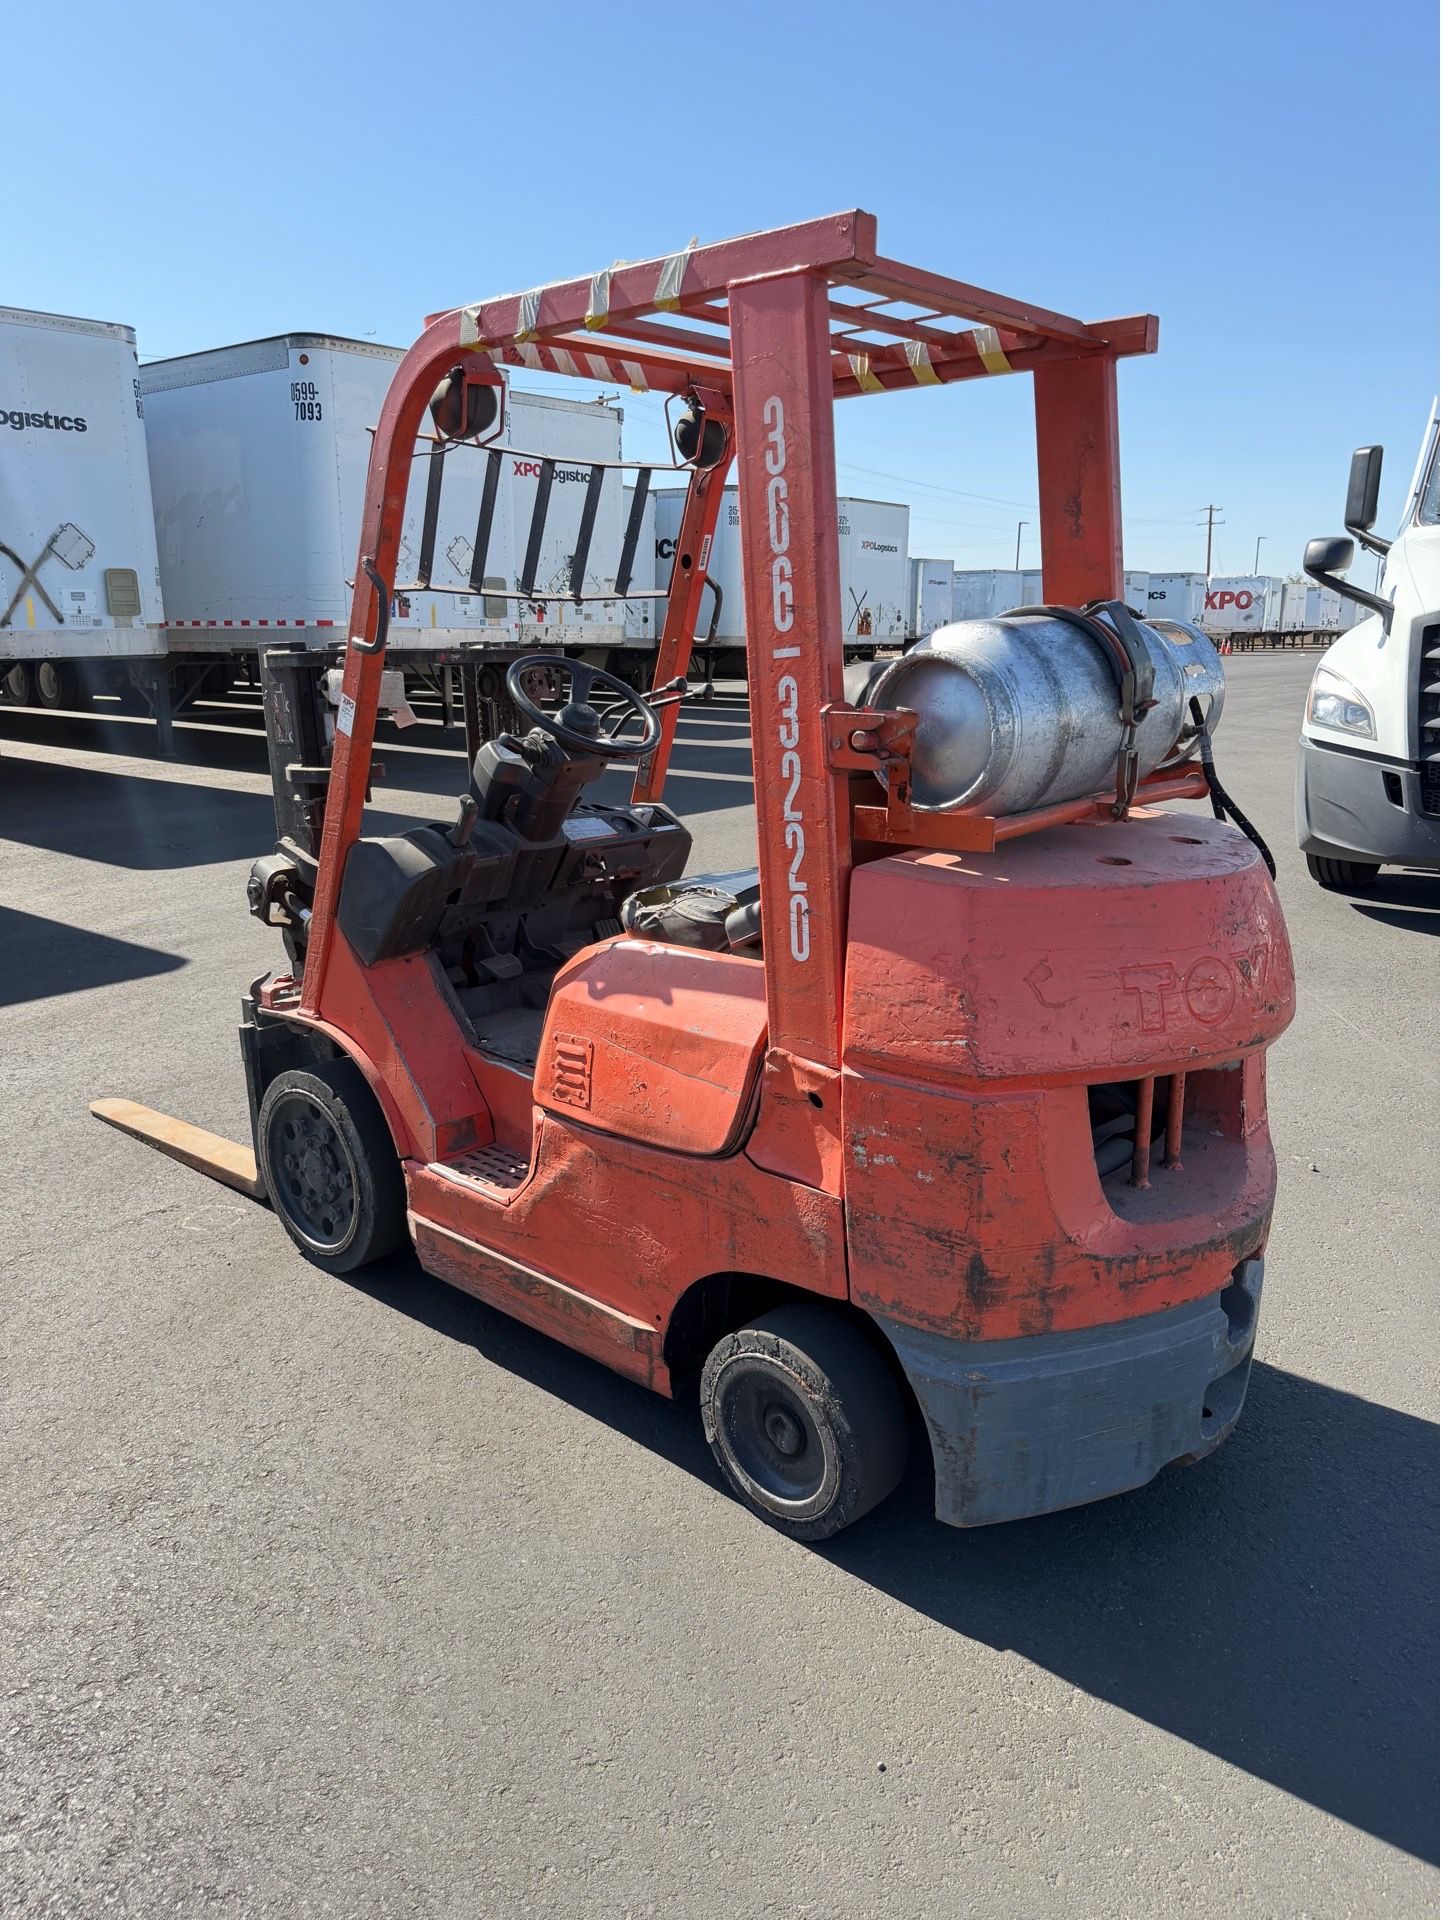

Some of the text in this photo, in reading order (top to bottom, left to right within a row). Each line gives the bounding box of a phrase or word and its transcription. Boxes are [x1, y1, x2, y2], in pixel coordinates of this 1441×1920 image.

[290, 382, 319, 402] 0599-
[294, 402, 322, 421] 7093
[551, 469, 591, 484] ogistic
[1204, 590, 1254, 610] XPO
[763, 395, 811, 962] 366-3220
